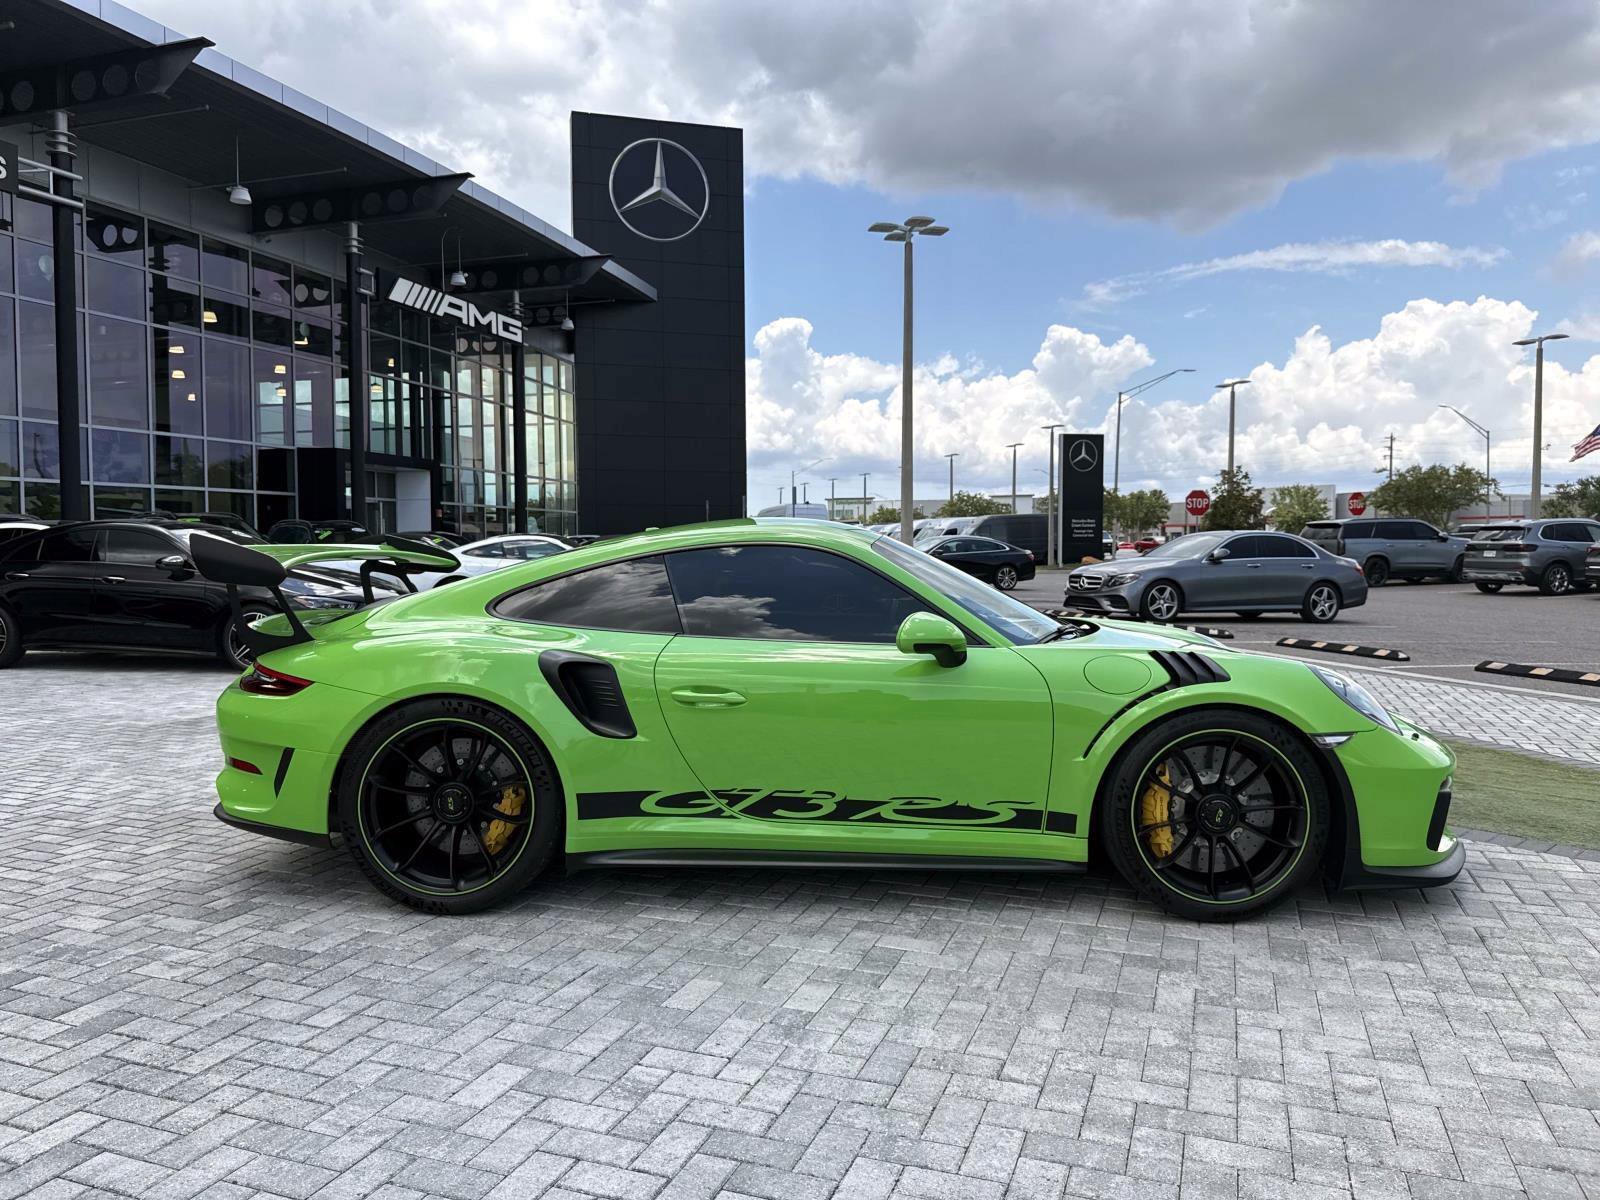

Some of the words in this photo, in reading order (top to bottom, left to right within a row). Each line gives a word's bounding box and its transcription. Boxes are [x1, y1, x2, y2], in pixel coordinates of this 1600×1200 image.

[436, 293, 523, 344] AMG
[1186, 497, 1209, 509] STOP
[1349, 499, 1365, 509] STO
[640, 788, 837, 819] GT3
[848, 796, 1036, 825] RS
